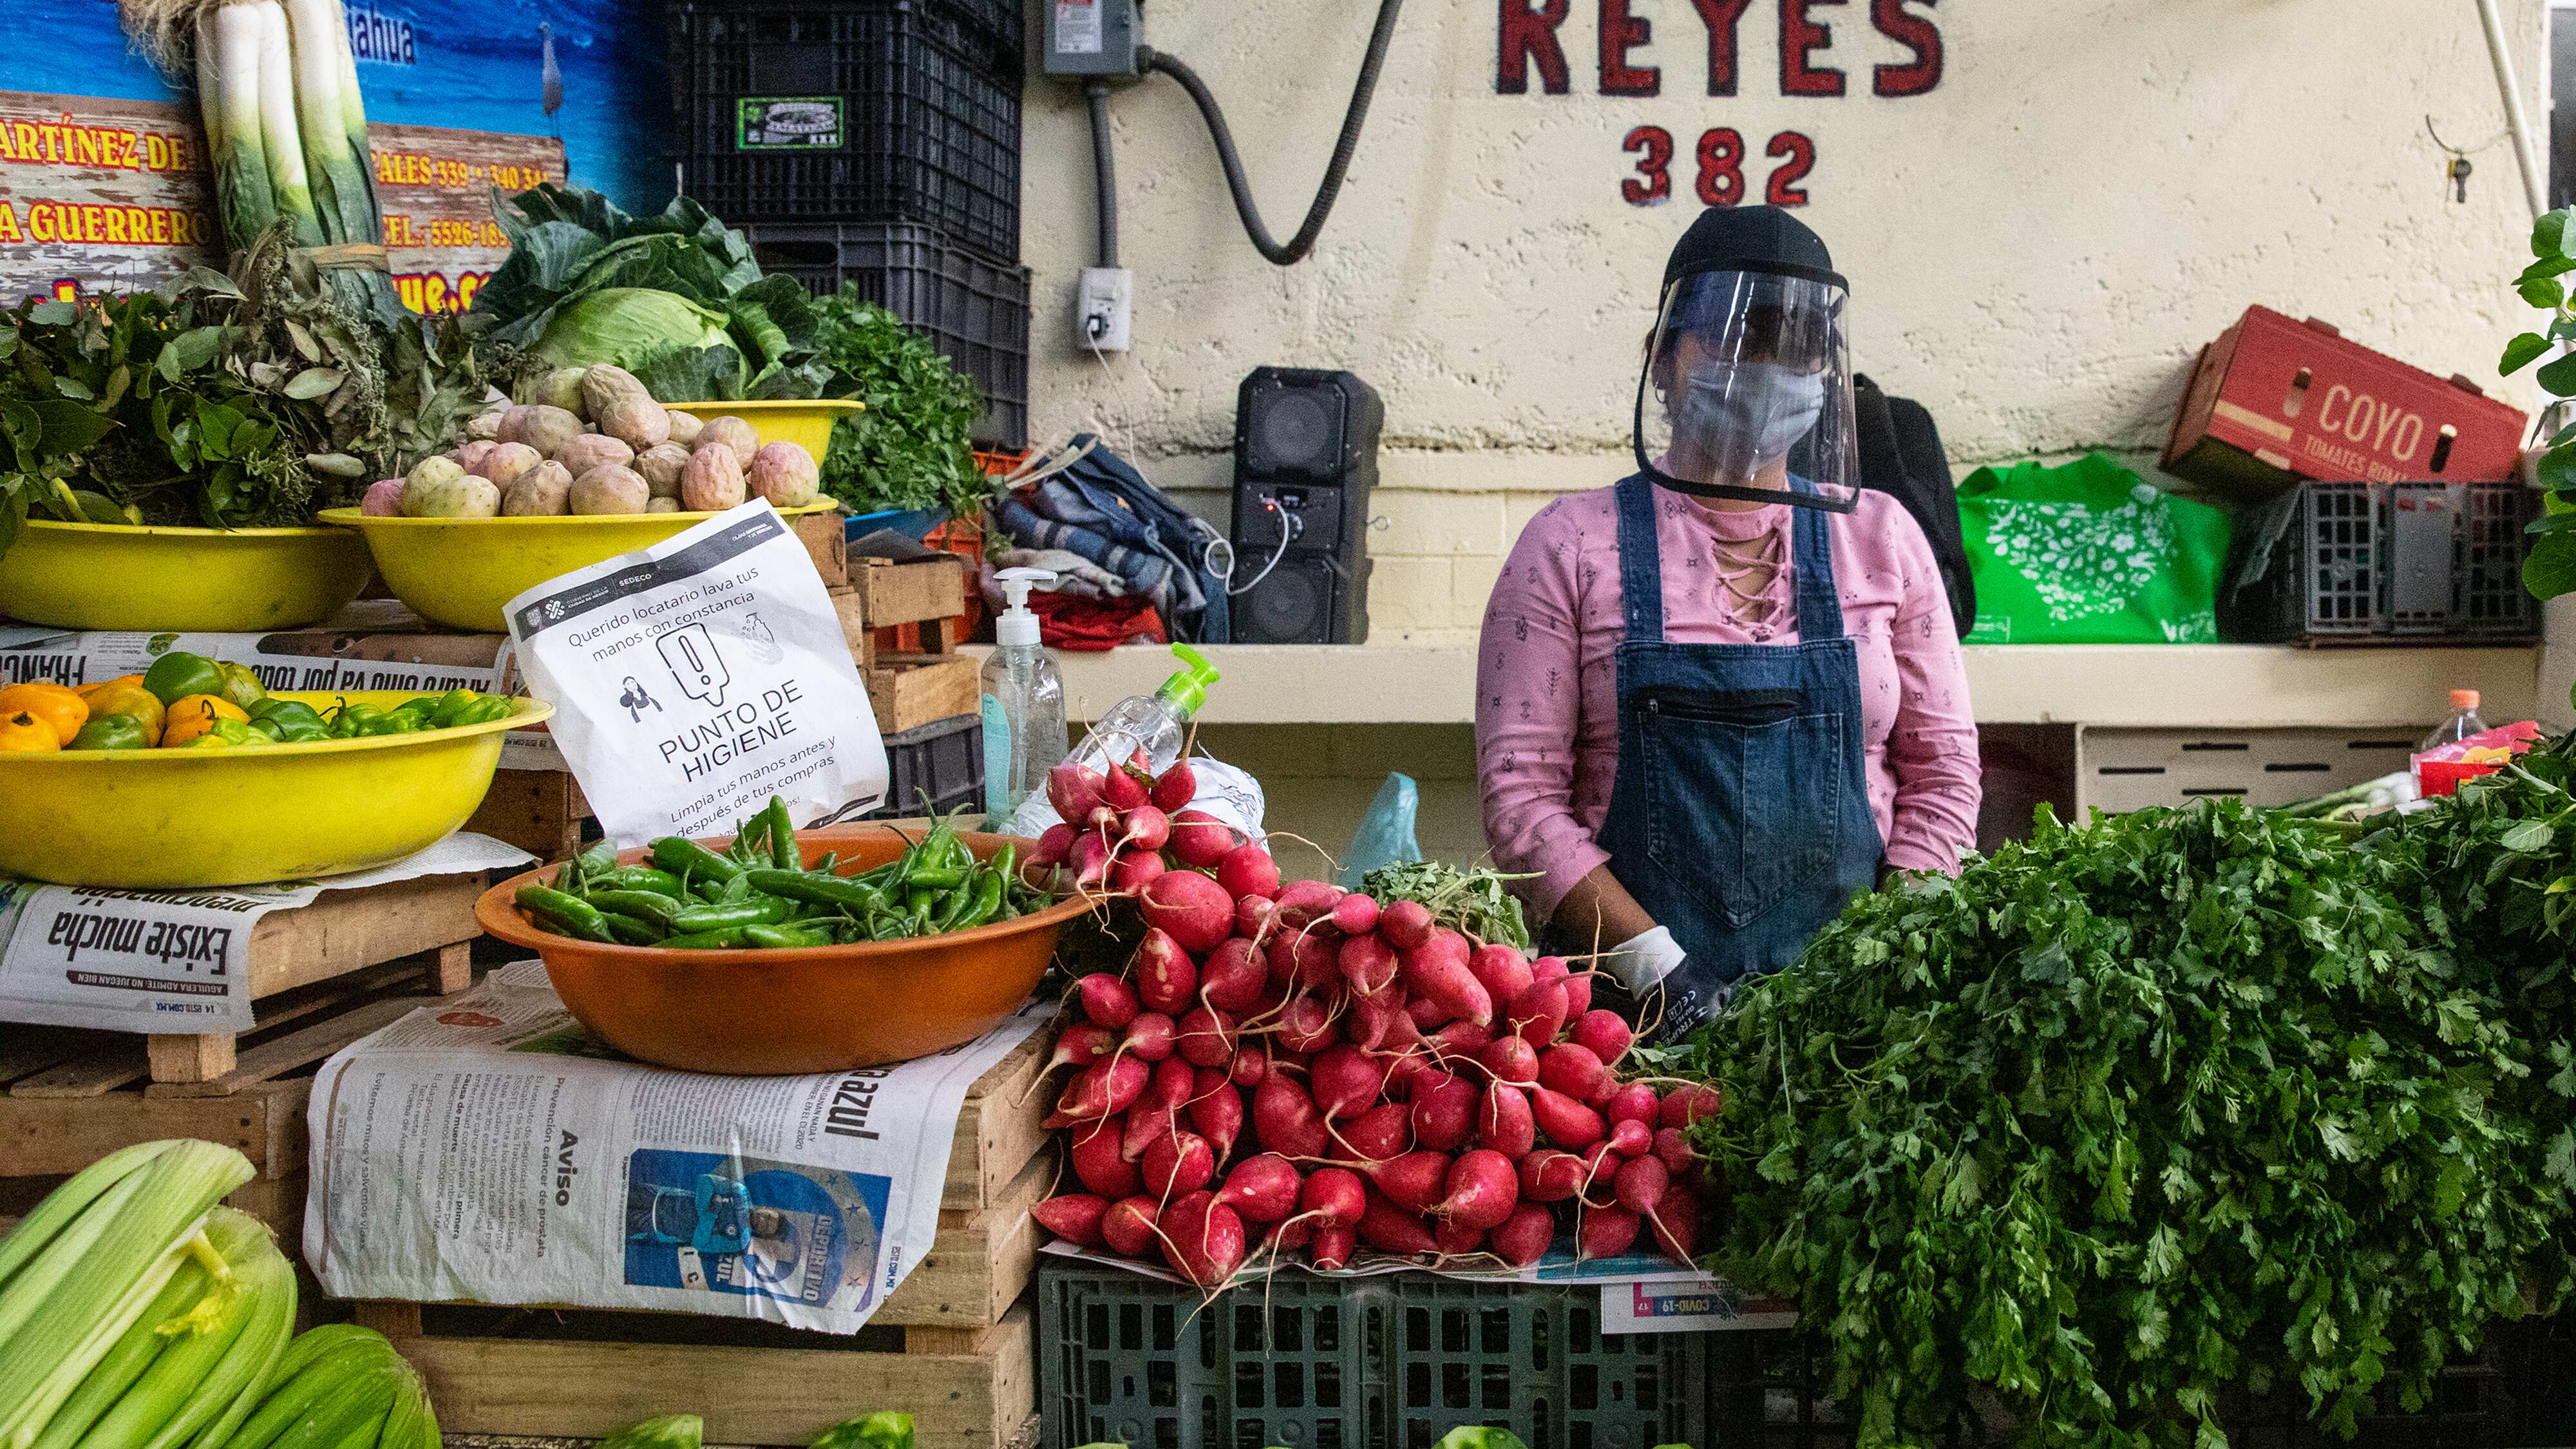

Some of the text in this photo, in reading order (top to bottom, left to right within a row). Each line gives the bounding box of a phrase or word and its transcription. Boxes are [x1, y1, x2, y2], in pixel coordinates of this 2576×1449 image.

[1496, 0, 1945, 97] REYES
[145, 132, 188, 171] DE
[1622, 126, 1817, 207] 382
[372, 151, 432, 185] ALES
[433, 159, 468, 187] 339
[30, 201, 211, 245] GUERRERO
[2320, 384, 2423, 461] COYO
[2304, 433, 2367, 475] TOMATES
[619, 573, 652, 587] SEDECO
[569, 567, 759, 647] Querido locatario lava tus
[592, 592, 755, 662] manos con constancia
[299, 659, 340, 691] por
[341, 670, 365, 691] va
[658, 679, 803, 764] PUNTO DE
[682, 711, 797, 782] HIGIENE
[670, 735, 836, 823] Limpia tus manos antes y
[676, 756, 835, 837] después de tus compras
[48, 911, 232, 976] Existe mucha
[78, 973, 97, 983] BIEN
[99, 976, 129, 986] JUEGAN
[132, 979, 143, 988] NO
[179, 983, 222, 993] AGUILERA
[156, 1002, 214, 1014] 14 ESTO.COM.MX
[366, 1072, 386, 1122] Evitemos
[404, 1083, 418, 1116] Prueba
[416, 1084, 429, 1109] Tacto
[459, 1074, 473, 1099] causa
[500, 1081, 509, 1099] que
[518, 1075, 535, 1110] Sociales
[456, 1102, 465, 1115] de
[516, 1112, 524, 1124] de
[544, 1077, 565, 1142] Prevención
[801, 1112, 810, 1120] EL
[804, 1102, 813, 1112] EN
[813, 1093, 827, 1115] GANAN
[824, 1081, 880, 1141] azul
[362, 1124, 373, 1155] mitos
[402, 1118, 410, 1131] de
[451, 1116, 460, 1153] muerte
[513, 1127, 522, 1141] los
[524, 1126, 533, 1138] de
[795, 1121, 807, 1150] CL2020
[808, 1116, 819, 1137] NADA
[520, 1141, 531, 1189] Seguridad
[540, 1146, 551, 1187] cáncer
[556, 1129, 578, 1206] Aviso
[361, 1166, 370, 1218] salvemos
[539, 1190, 548, 1206] de
[452, 1201, 464, 1240] primera
[803, 1216, 834, 1302] DEPORTIVO
[1662, 1300, 1710, 1312] COVID-19
